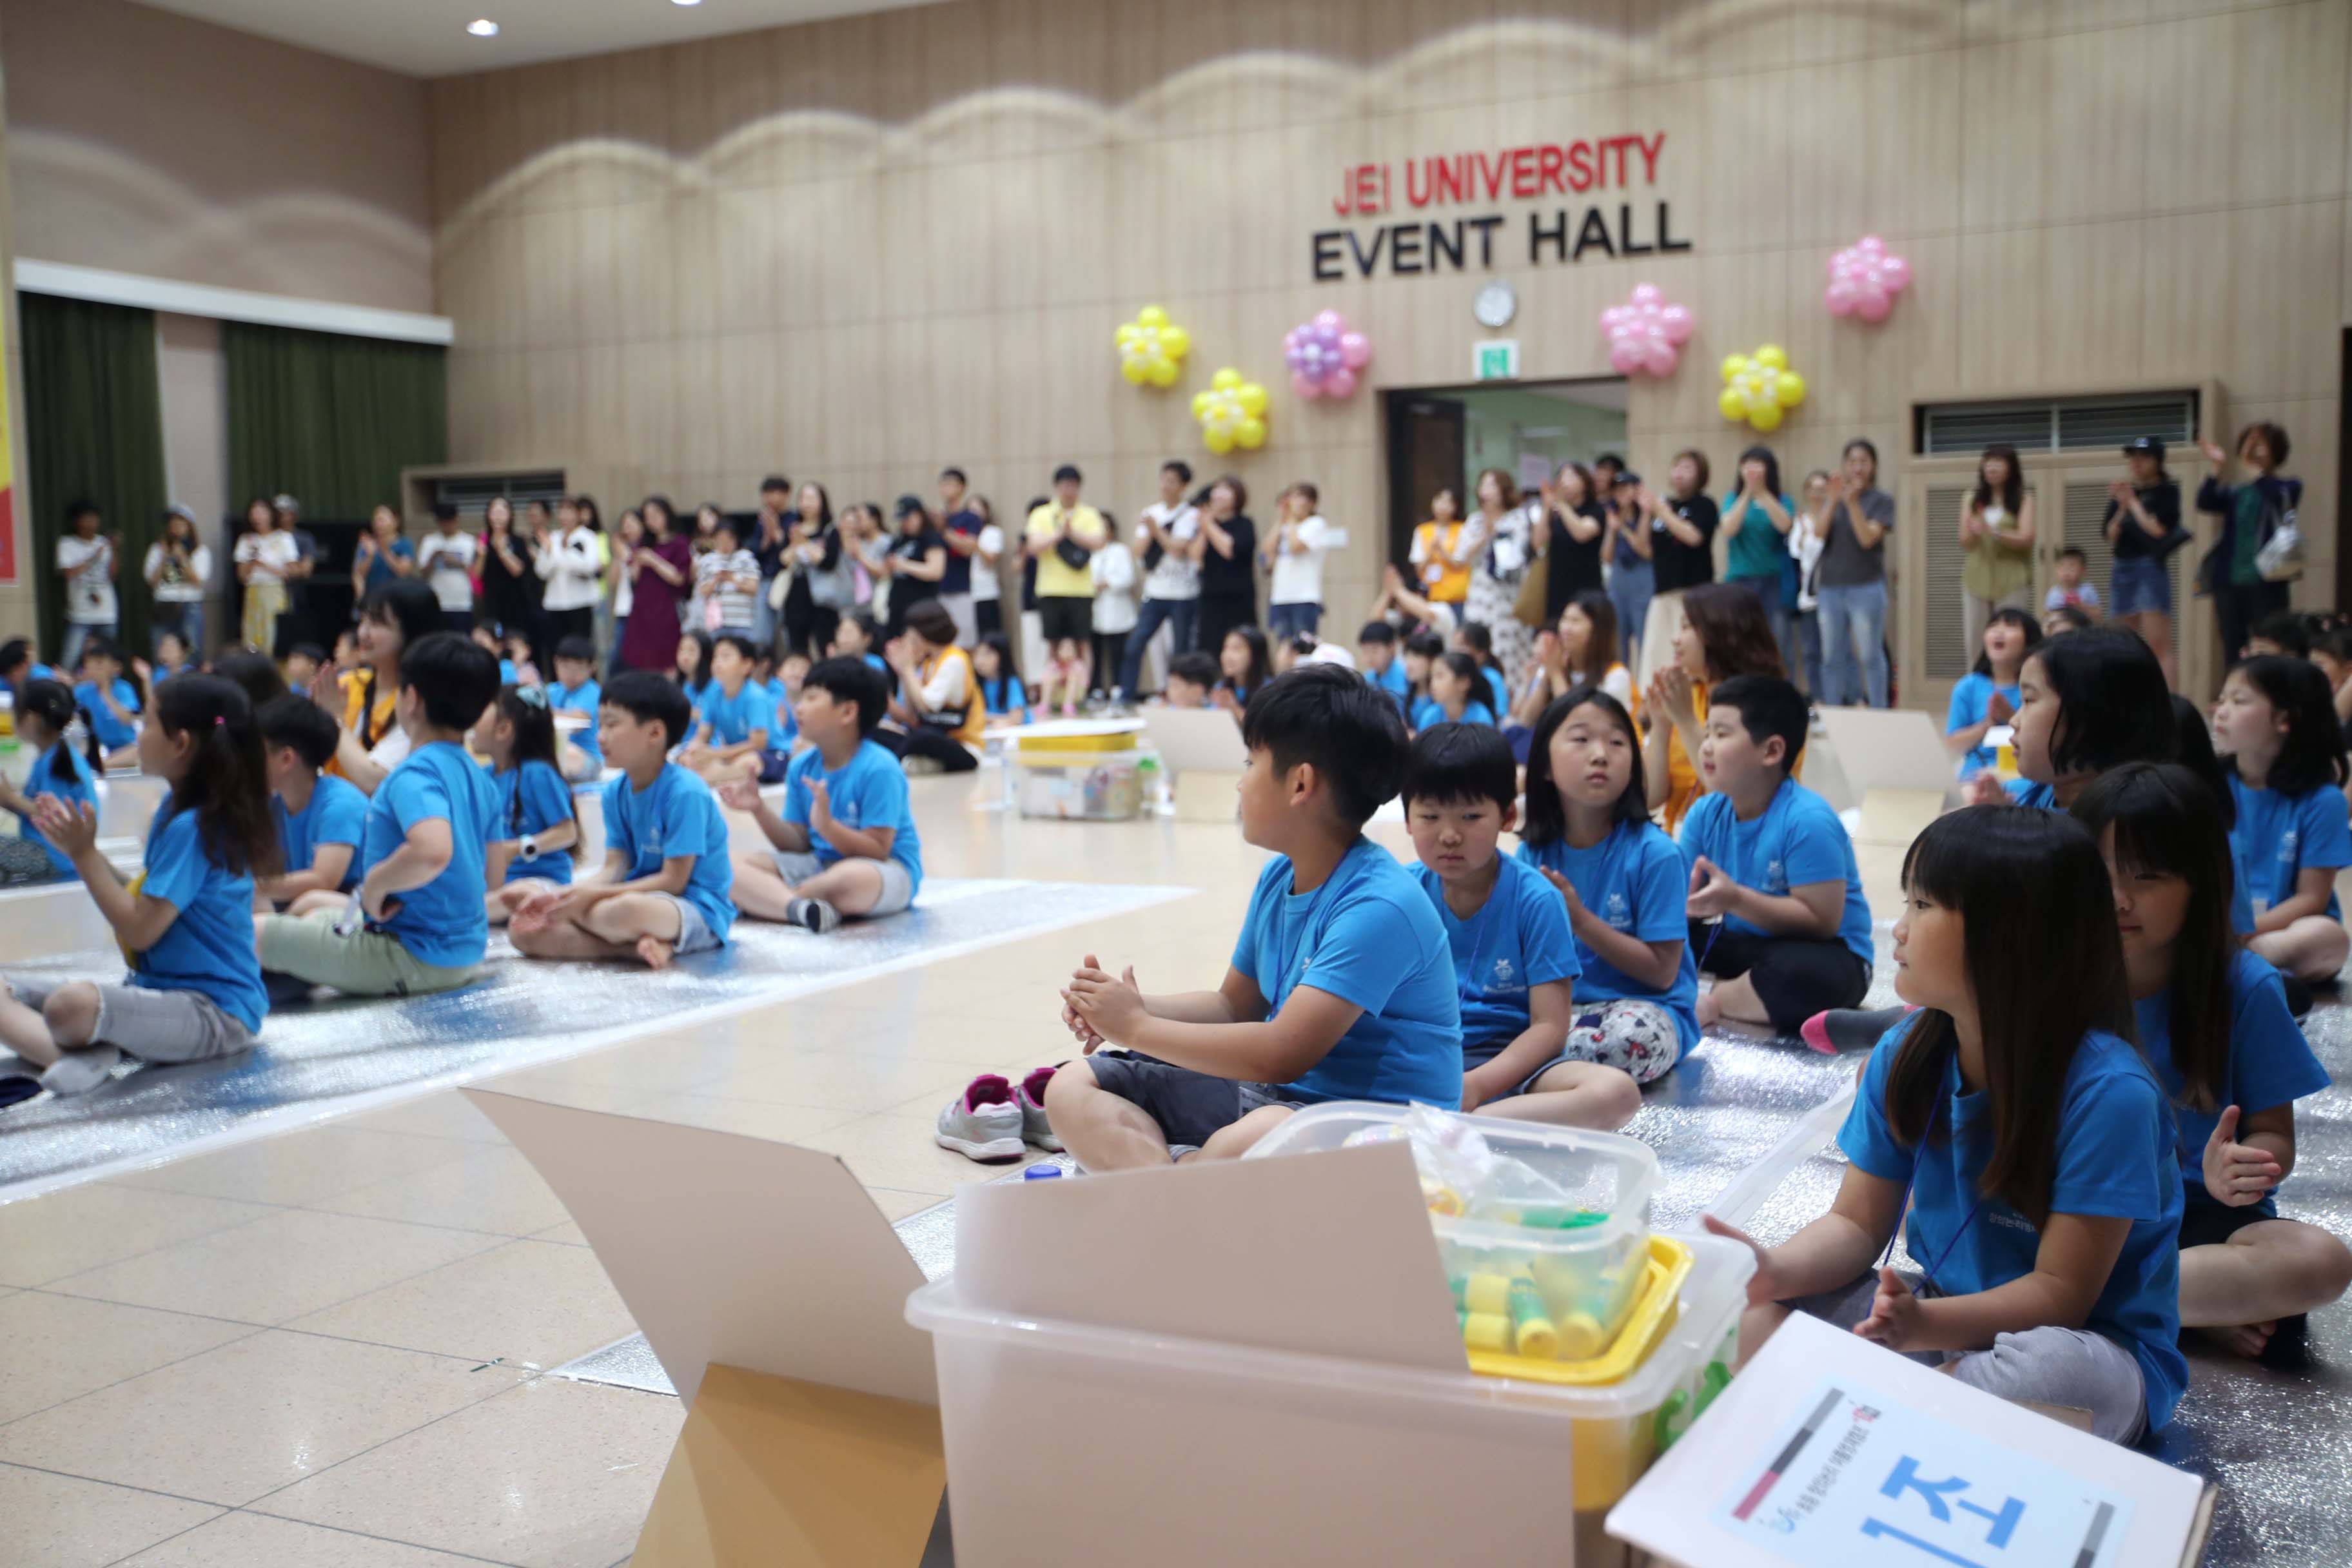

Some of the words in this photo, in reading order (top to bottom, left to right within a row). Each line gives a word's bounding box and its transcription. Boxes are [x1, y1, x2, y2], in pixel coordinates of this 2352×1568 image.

[1333, 162, 1391, 217] JEI
[1405, 131, 1666, 210] UNIVERSITY
[1312, 215, 1505, 282] EVENT
[1529, 200, 1692, 264] HALL
[1860, 1454, 2026, 1568] 1조
